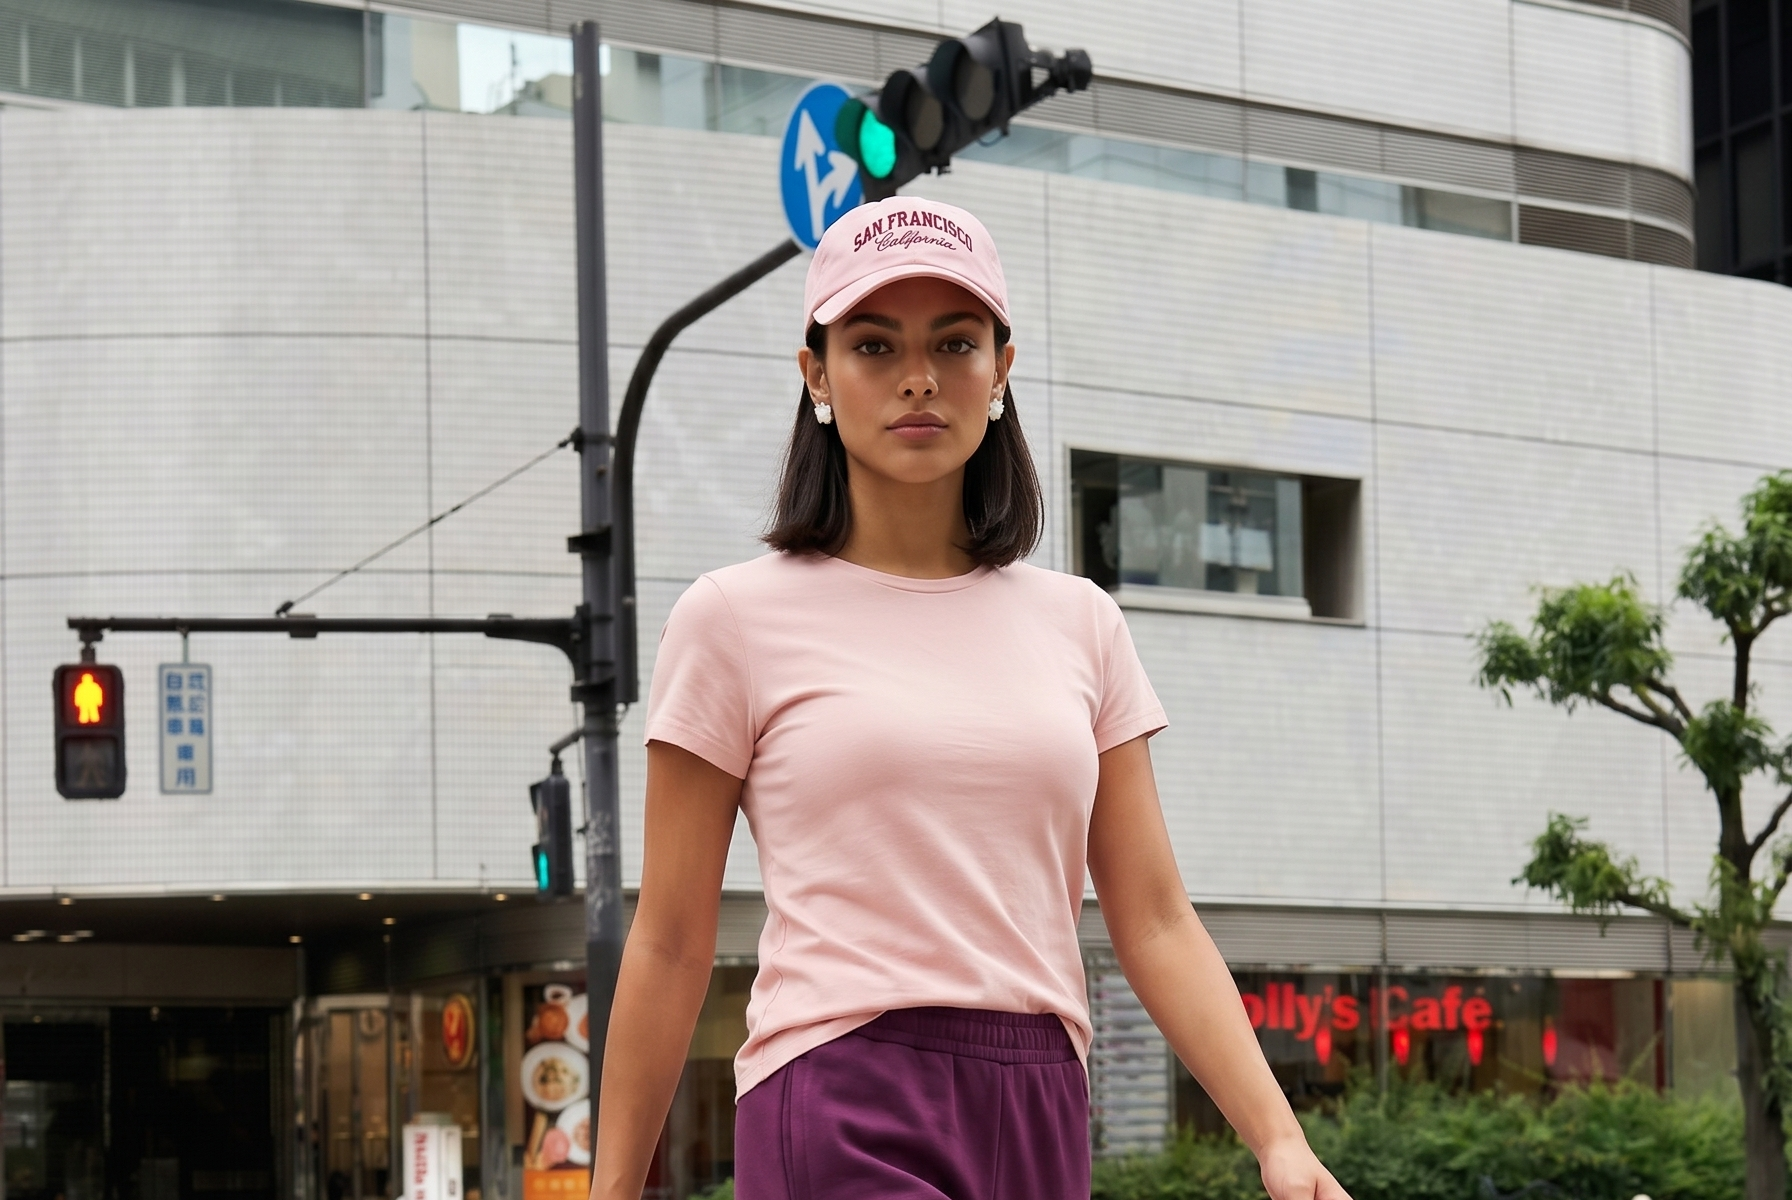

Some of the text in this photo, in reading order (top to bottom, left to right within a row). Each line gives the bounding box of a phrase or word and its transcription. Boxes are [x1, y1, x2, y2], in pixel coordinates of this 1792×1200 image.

[853, 210, 973, 253] SAN FRANCISCO
[875, 230, 957, 252] California
